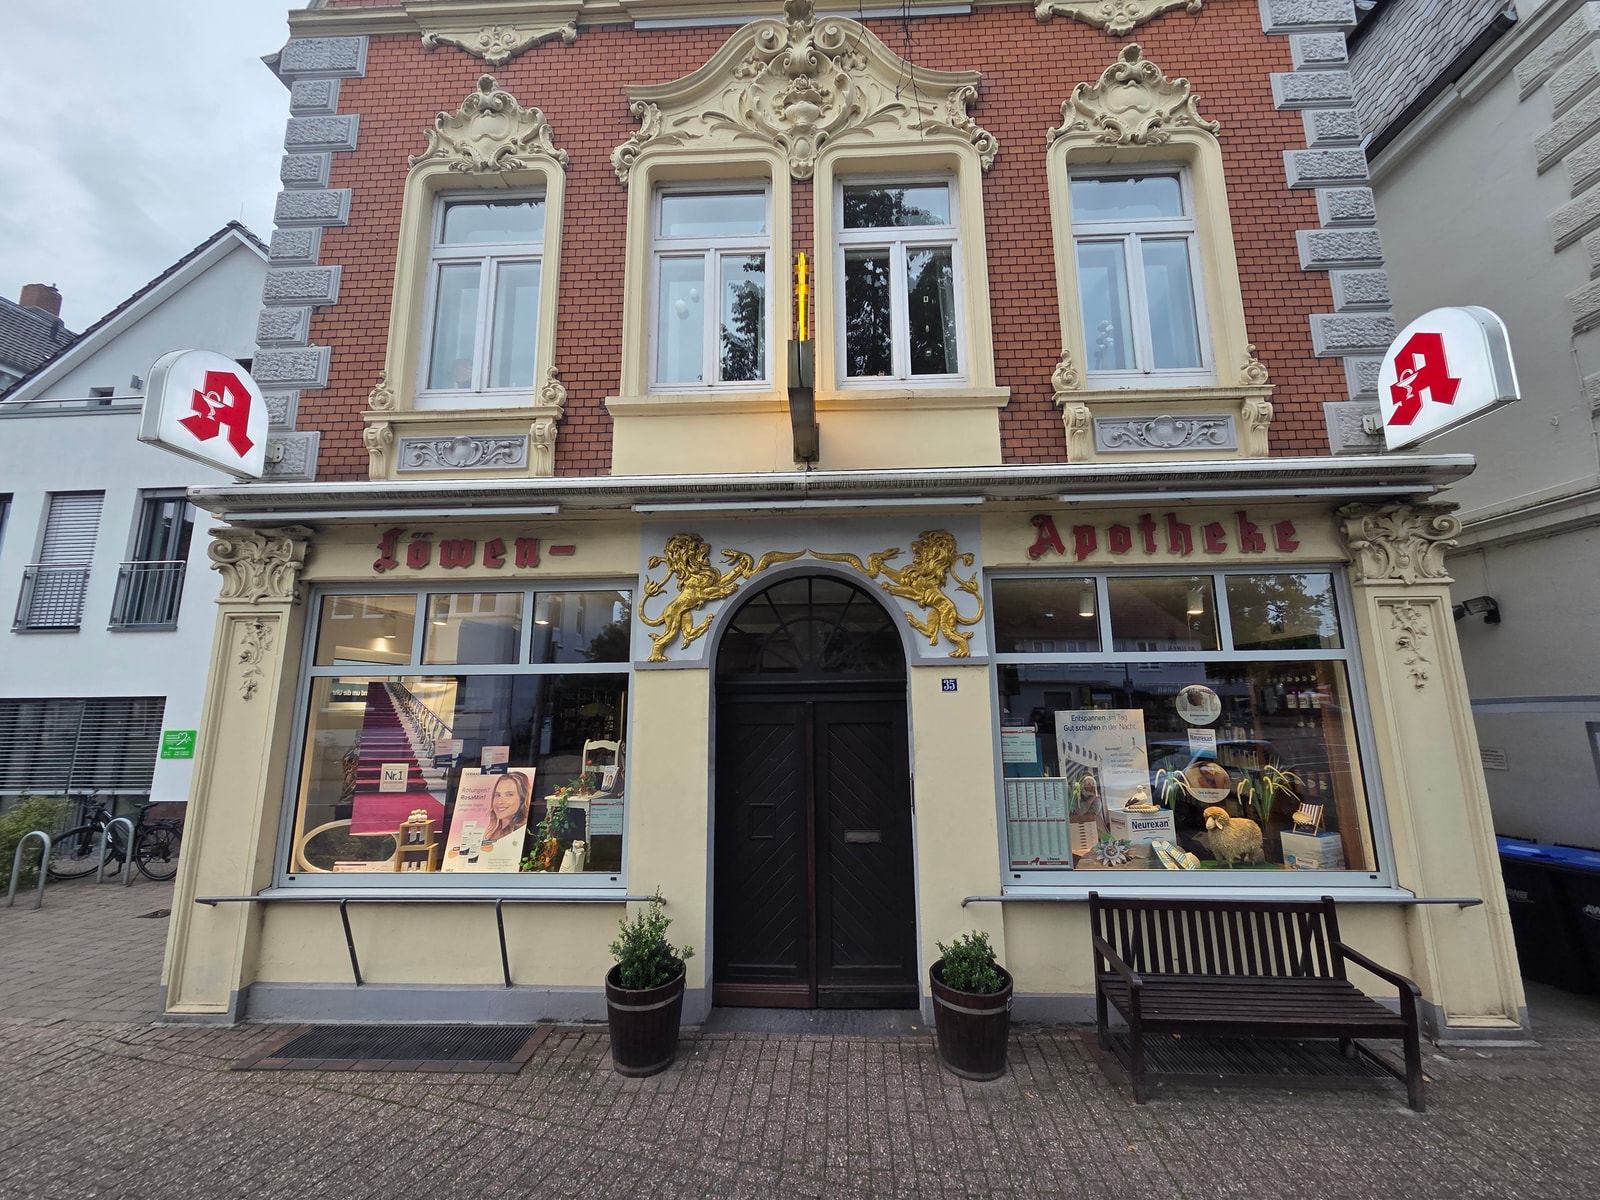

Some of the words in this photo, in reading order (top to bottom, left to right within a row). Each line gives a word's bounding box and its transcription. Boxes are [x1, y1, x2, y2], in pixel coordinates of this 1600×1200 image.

[373, 527, 576, 573] Löwen-
[1027, 510, 1301, 561] Apotheke
[943, 679, 956, 691] 35
[1071, 714, 1105, 722] Entspannen
[1117, 714, 1128, 722] Tag
[1063, 724, 1075, 732] Gut
[1075, 722, 1101, 731] schlafen
[1107, 722, 1118, 730] der
